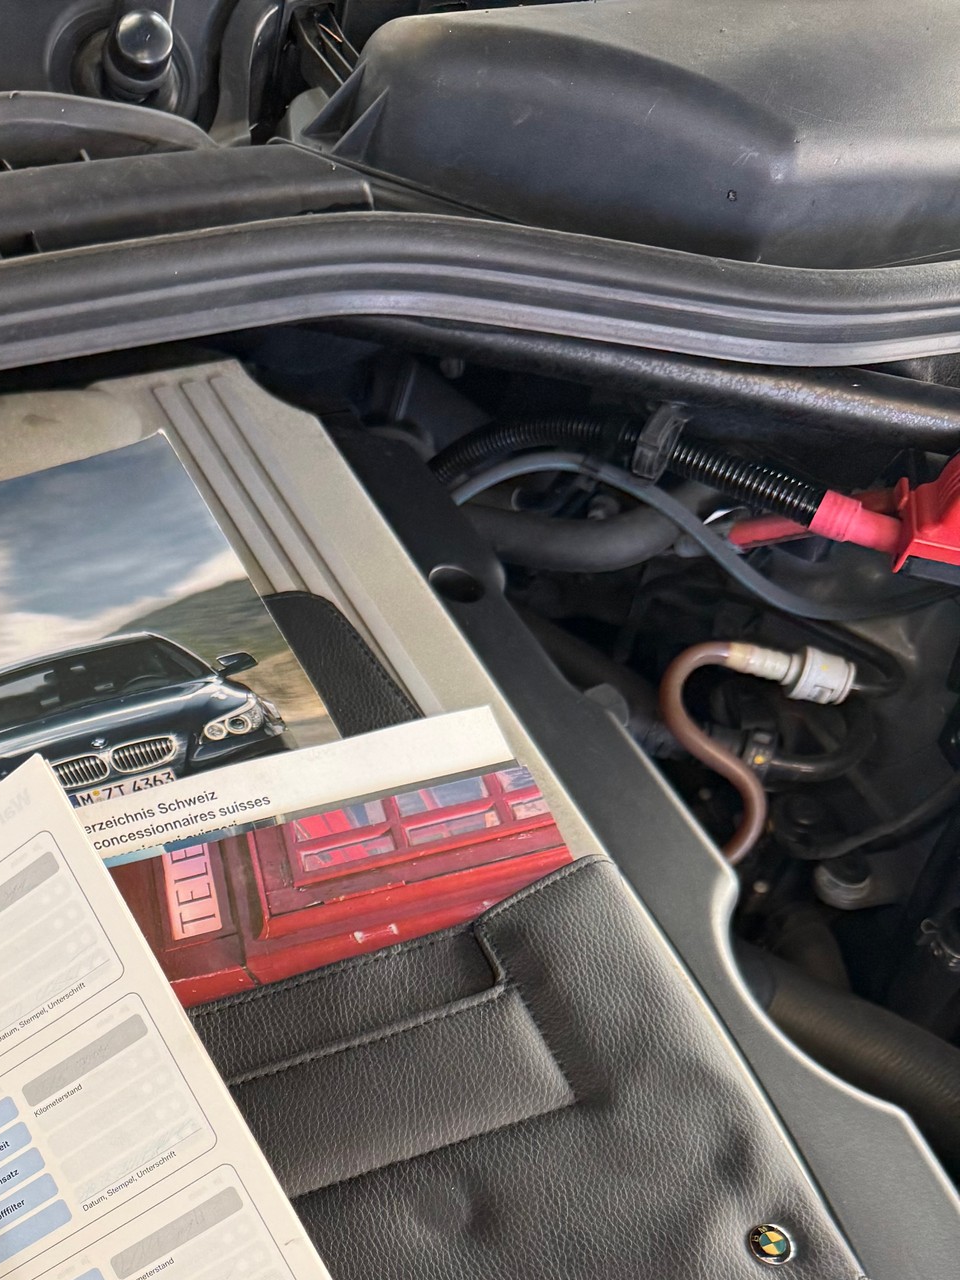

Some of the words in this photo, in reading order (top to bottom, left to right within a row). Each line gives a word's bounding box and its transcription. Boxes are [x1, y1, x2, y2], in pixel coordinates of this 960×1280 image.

[93, 809, 216, 850] concessionnaires
[219, 796, 271, 817] suisses
[158, 790, 218, 814] Schweiz
[19, 1007, 48, 1029] Stempel,
[48, 981, 86, 1010] Unterschrift
[34, 1084, 83, 1117] Kilometerstand
[83, 1194, 107, 1211] Datum,
[107, 1176, 137, 1197] Stempel,
[137, 1151, 176, 1178] Unterschrift
